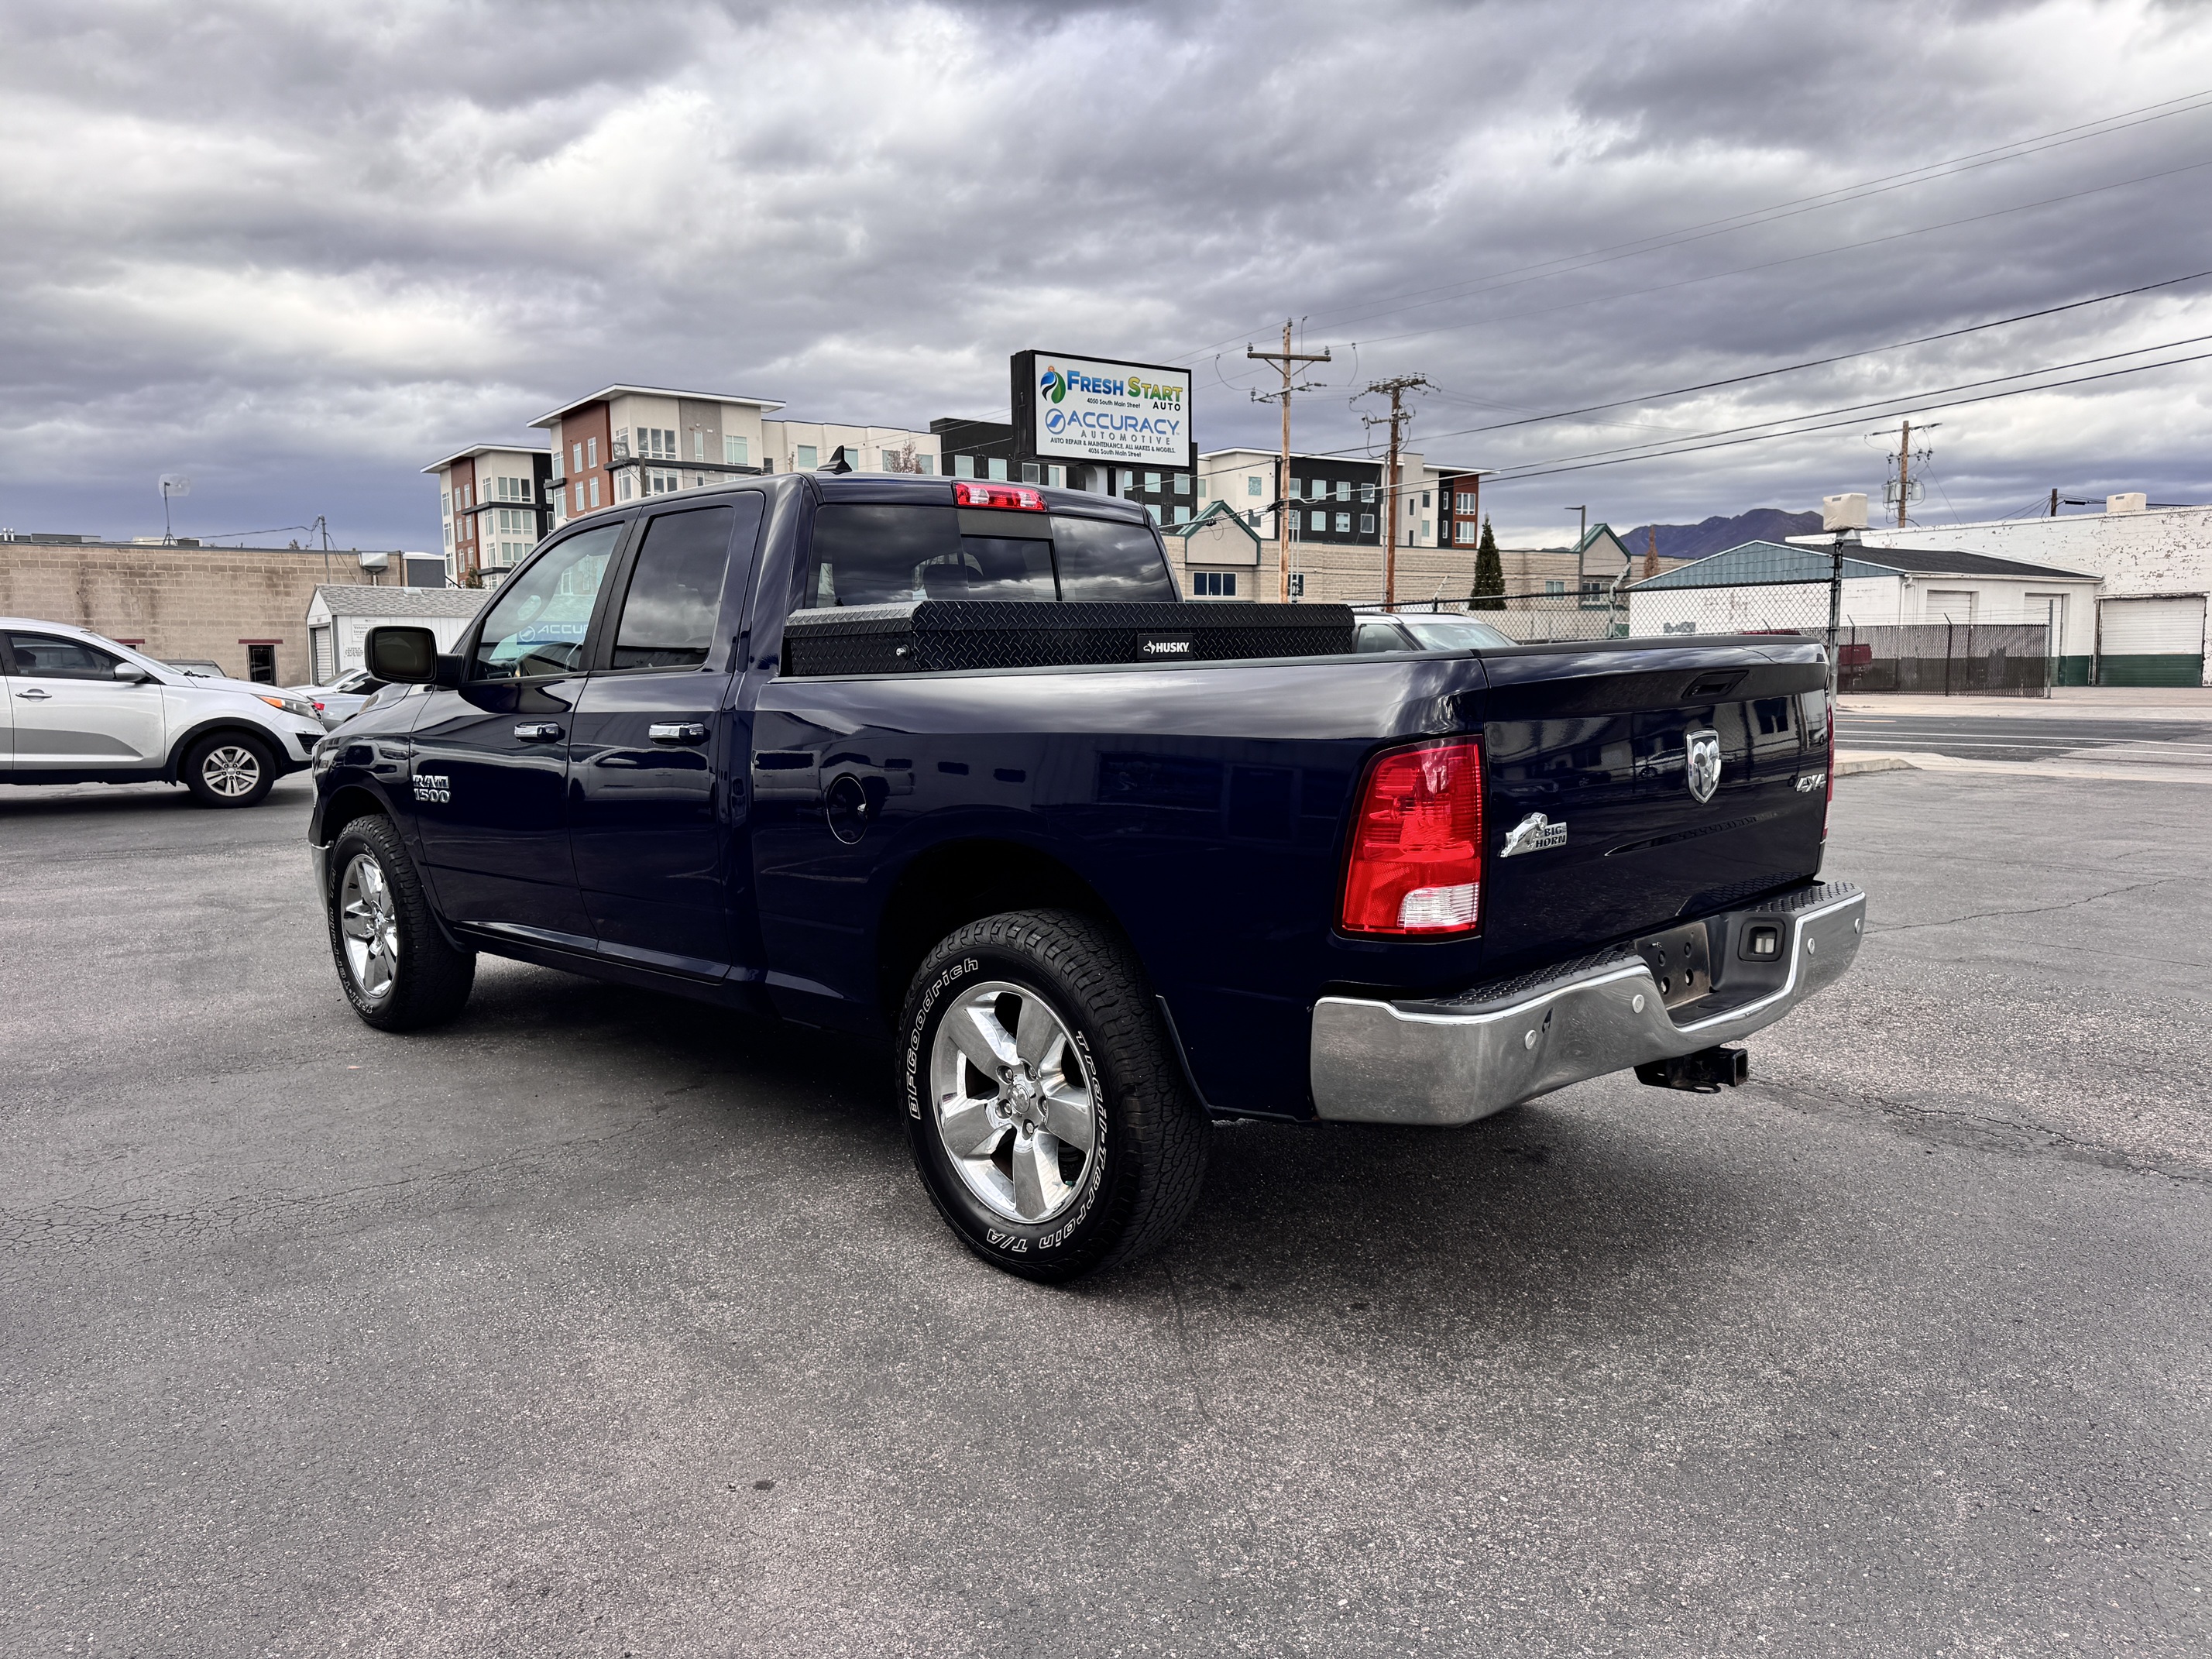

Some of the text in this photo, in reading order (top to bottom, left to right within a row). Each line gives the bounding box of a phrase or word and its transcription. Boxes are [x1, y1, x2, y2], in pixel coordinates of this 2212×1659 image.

[1067, 369, 1183, 402] FRESH START
[1152, 401, 1181, 411] AUTO
[1066, 410, 1180, 435] ACCURACY
[1080, 429, 1170, 445] AUTOMOTIVE
[538, 624, 589, 634] ACCU
[1156, 642, 1190, 653] HUSKY
[412, 775, 449, 788] RAM
[414, 788, 451, 803] 1500
[1544, 826, 1562, 836] BIG
[1536, 835, 1566, 848] HORN
[906, 957, 979, 1121] BFGoodrich
